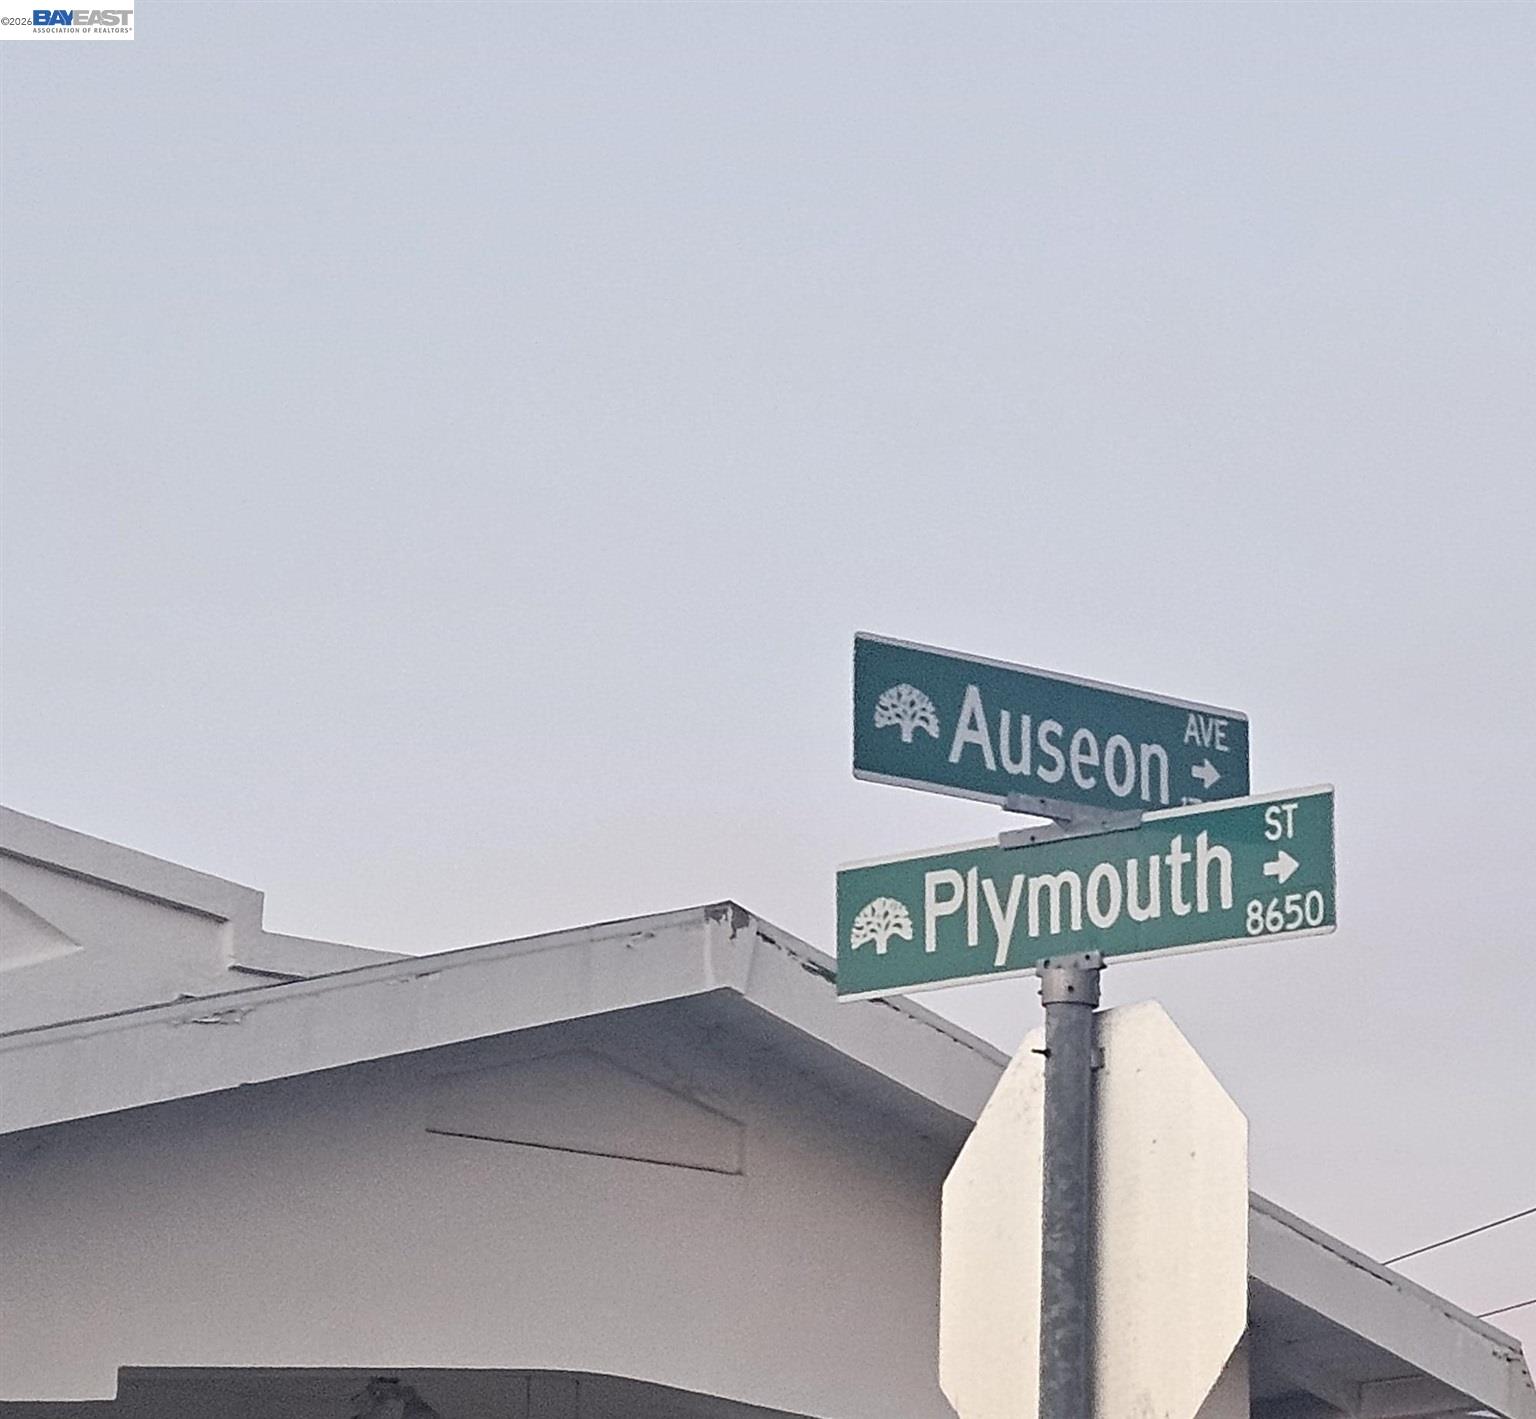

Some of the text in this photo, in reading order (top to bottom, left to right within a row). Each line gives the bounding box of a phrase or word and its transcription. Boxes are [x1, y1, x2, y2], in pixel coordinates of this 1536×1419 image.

[948, 684, 1170, 805] Auseon
[1183, 713, 1229, 752] AVE
[1265, 803, 1299, 841] ST
[923, 830, 1234, 967] Plymouth
[1245, 890, 1325, 937] 8650
